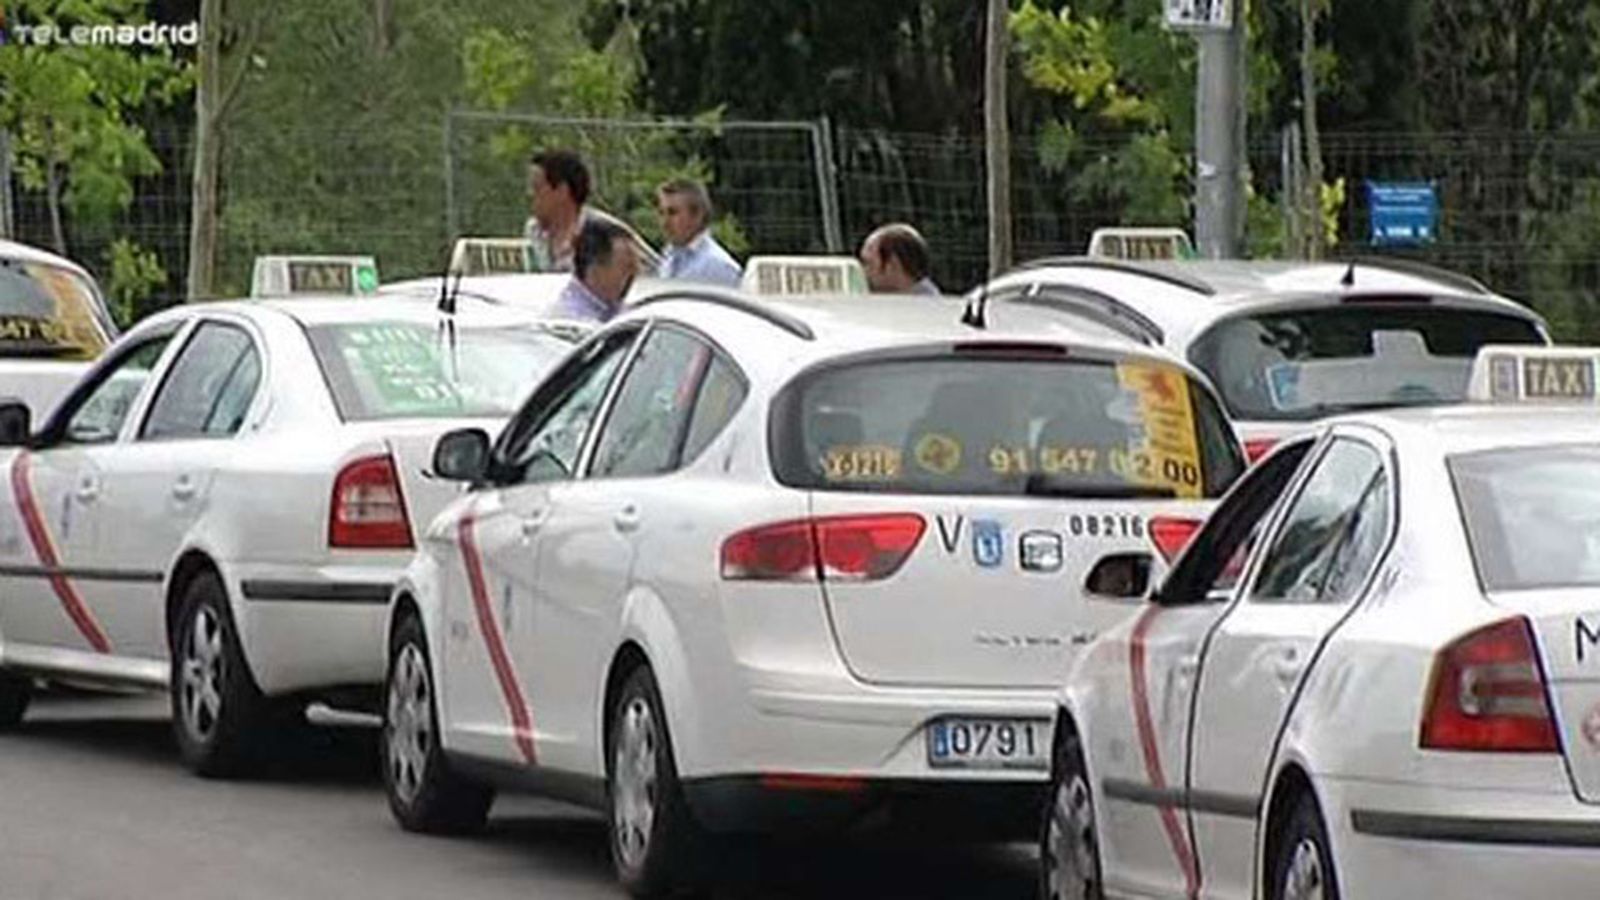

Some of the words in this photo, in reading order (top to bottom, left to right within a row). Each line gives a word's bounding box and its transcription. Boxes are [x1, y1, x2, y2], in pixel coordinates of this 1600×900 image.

[292, 265, 350, 290] TAXI
[1527, 361, 1590, 394] TAXI
[988, 448, 1030, 473] 91
[1162, 458, 1198, 487] 00
[936, 514, 964, 553] V
[1069, 515, 1144, 537] 08216
[951, 723, 1035, 757] 0791
